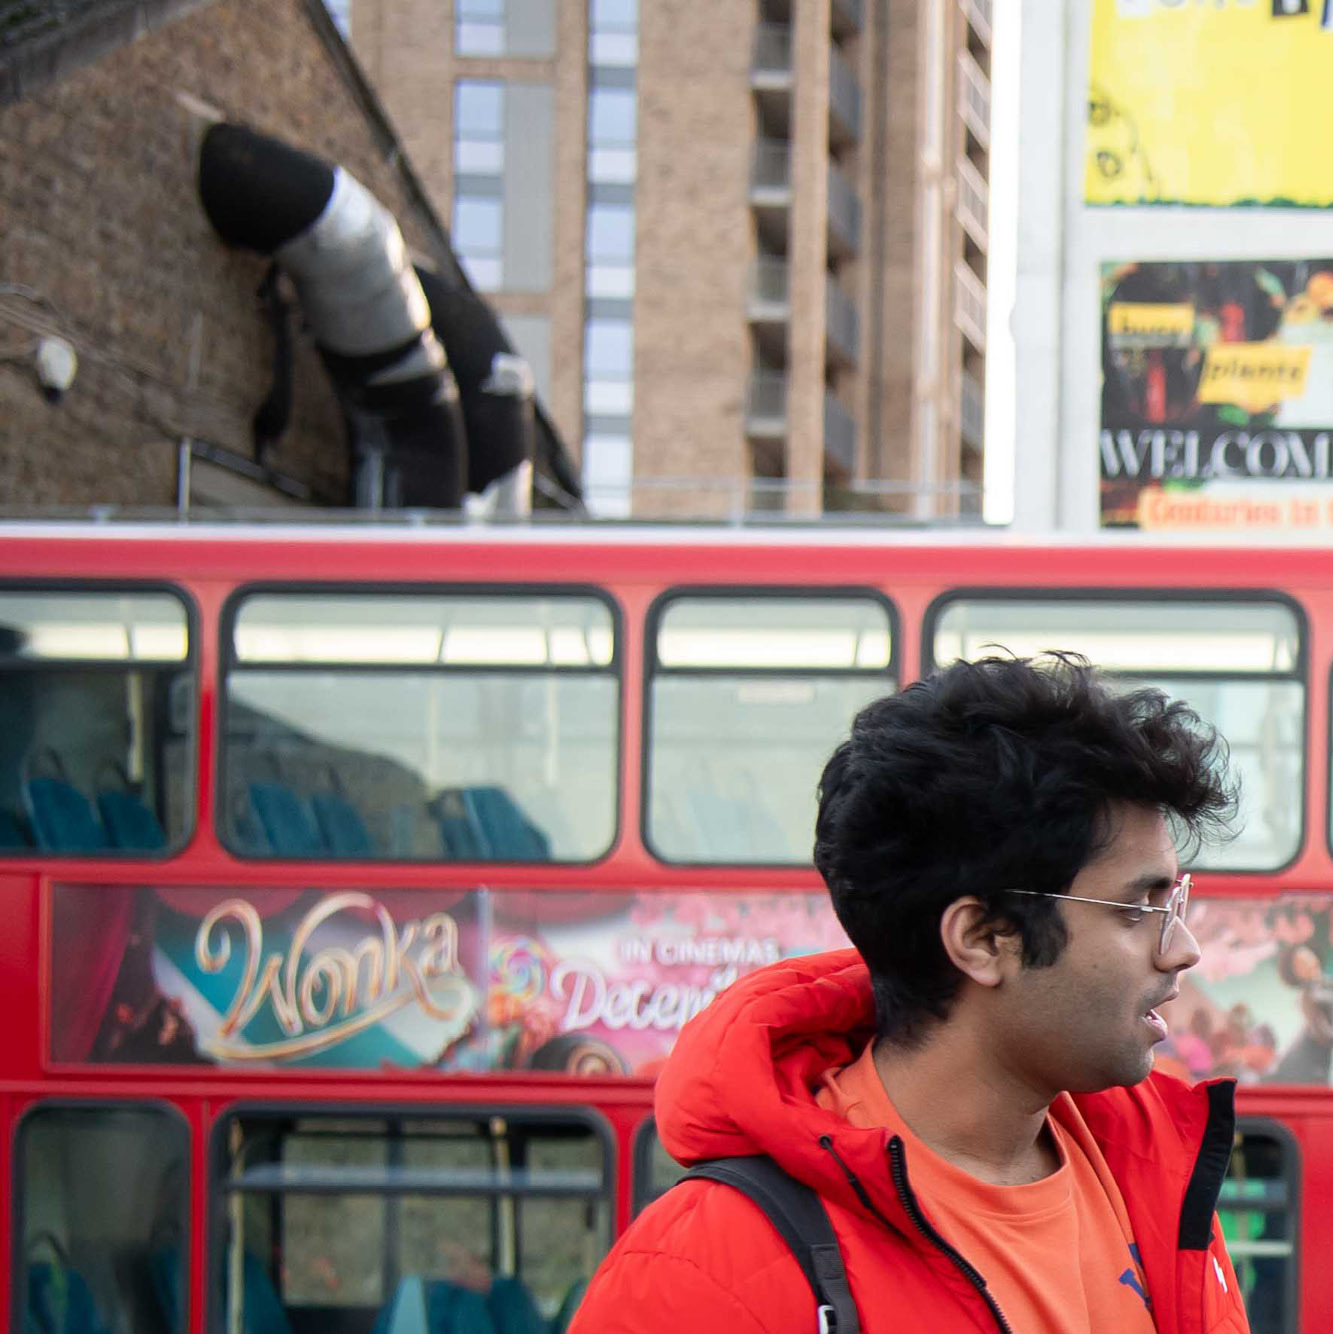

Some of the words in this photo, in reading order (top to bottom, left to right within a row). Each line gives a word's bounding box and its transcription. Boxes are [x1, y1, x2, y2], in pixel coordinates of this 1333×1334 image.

[196, 892, 478, 1057] Wonka
[621, 937, 653, 963] IN
[658, 936, 780, 965] CINEMAS
